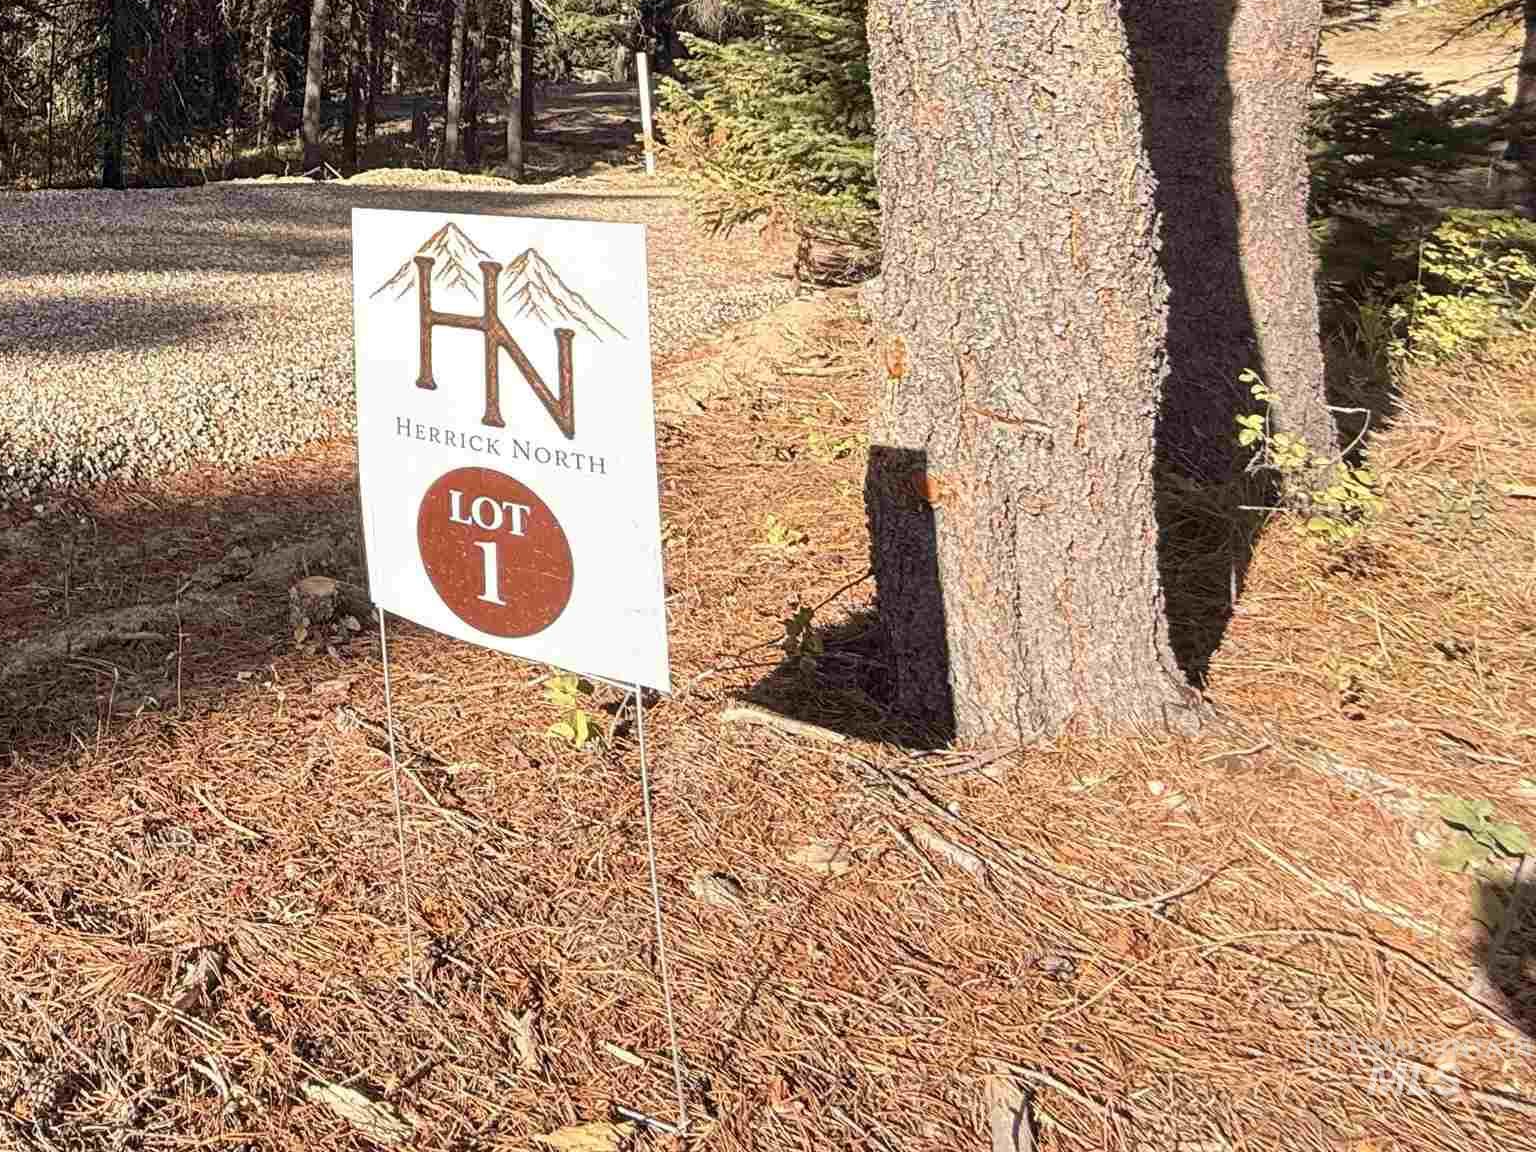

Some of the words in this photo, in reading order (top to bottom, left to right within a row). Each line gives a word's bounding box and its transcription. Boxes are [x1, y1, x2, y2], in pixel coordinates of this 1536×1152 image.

[414, 256, 576, 440] HN
[396, 416, 502, 456] HERRICK
[511, 438, 608, 475] NORTH
[448, 489, 531, 537] LOT
[473, 541, 507, 607] 1
